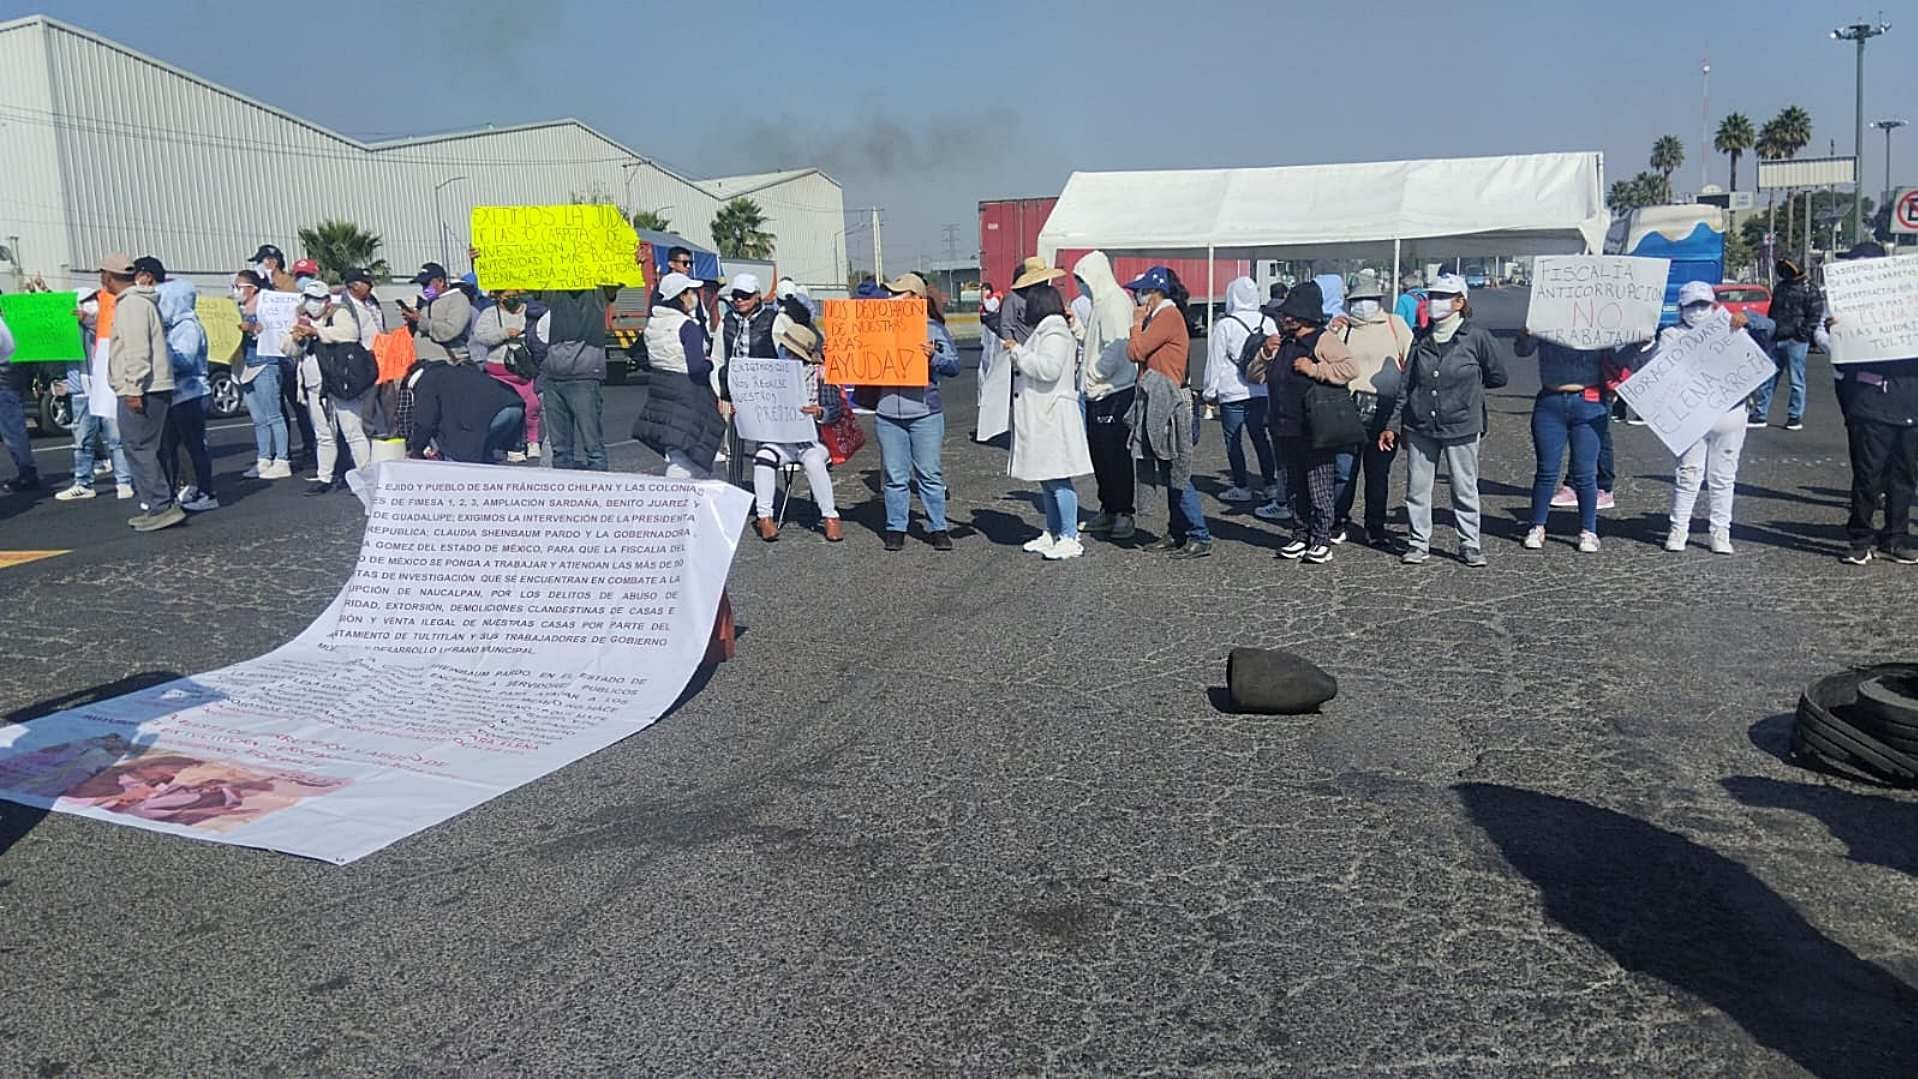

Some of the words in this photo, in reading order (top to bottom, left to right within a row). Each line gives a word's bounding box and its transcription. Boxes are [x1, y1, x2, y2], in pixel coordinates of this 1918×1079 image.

[825, 299, 848, 320] NOS
[1573, 299, 1623, 329] NO
[1653, 371, 1722, 434] ELENA
[425, 483, 465, 491] PUEBLO
[568, 484, 612, 492] CHILPAN
[391, 498, 406, 506] DE
[606, 499, 644, 507] BENITO
[373, 511, 389, 519] DE
[458, 514, 505, 522] EXIGIMOS
[632, 514, 695, 523] PRESIDENTA
[481, 529, 541, 537] SHEINBAUM
[545, 530, 581, 538] PARDO
[585, 530, 591, 538] Y
[614, 529, 690, 538] GOBERNADORA
[440, 544, 481, 552] ESTADO
[484, 544, 498, 552] DE
[578, 546, 600, 554] QUE
[369, 556, 384, 564] DE
[430, 558, 443, 566] SE
[446, 558, 481, 567] PONGA
[494, 560, 547, 568] TRABAJAR
[559, 561, 610, 569] ATIENDAN
[659, 561, 672, 569] DE
[381, 572, 396, 580] DE
[520, 576, 589, 584] ENCUENTRAN
[491, 590, 511, 598] POR
[548, 591, 591, 599] DELITOS
[622, 592, 657, 600] ABUSO
[450, 604, 523, 612] DEMOLICIONES
[527, 605, 605, 615] CLANDESTINAS
[610, 607, 624, 615] DE
[629, 607, 664, 615] CASAS
[668, 607, 676, 615] E
[383, 617, 415, 625] VENTA
[421, 618, 456, 626] ILEGAL
[482, 619, 535, 627] NUESTRAS
[582, 621, 602, 629] POR
[609, 622, 644, 630] PARTE
[651, 623, 670, 631] DEL
[394, 632, 408, 640] DE
[505, 633, 586, 643] TRABAJADORES
[591, 636, 606, 644] DE
[610, 635, 667, 647] GOBIERNO
